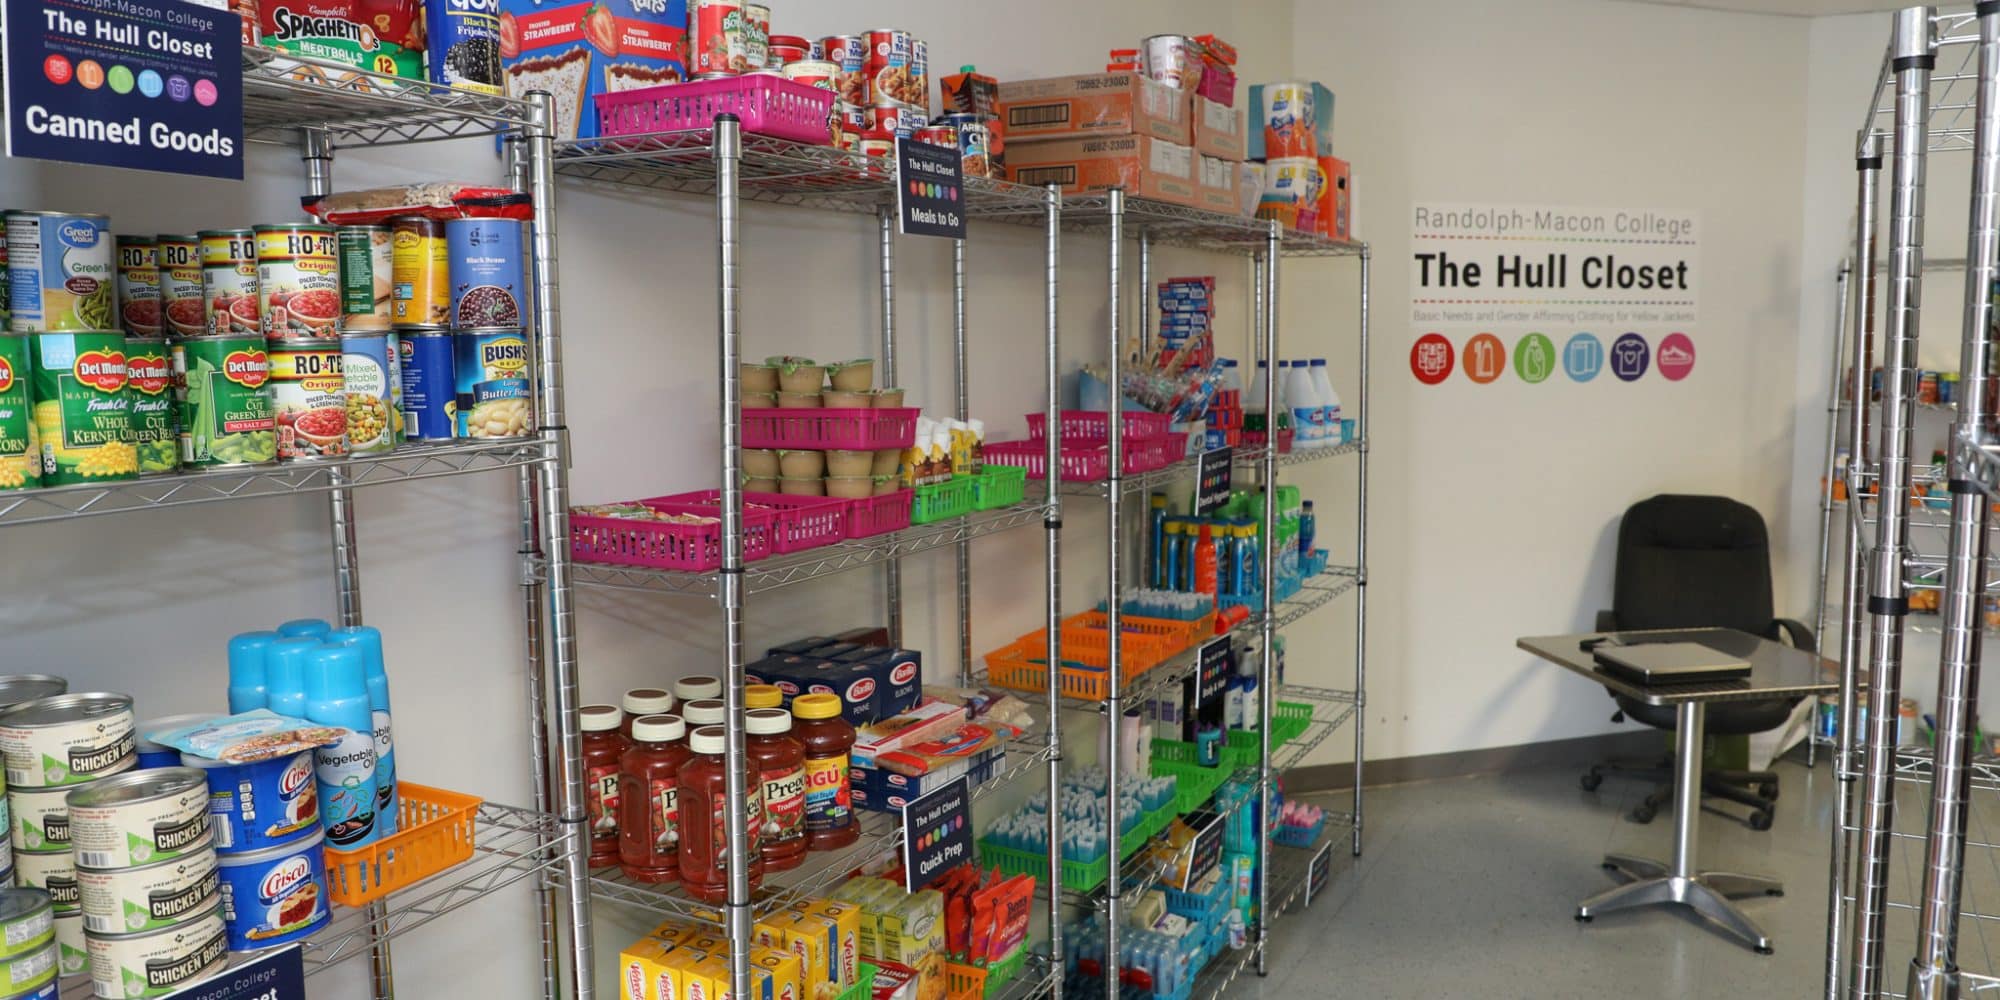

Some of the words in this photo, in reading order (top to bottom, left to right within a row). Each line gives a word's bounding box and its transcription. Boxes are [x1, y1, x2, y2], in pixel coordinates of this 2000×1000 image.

[167, 10, 214, 31] College
[43, 9, 87, 36] The
[95, 19, 140, 46] Hull
[147, 30, 213, 60] Closet
[524, 22, 577, 41] STRAWBERRY
[622, 34, 672, 51] STRAWBERRY
[300, 41, 363, 64] MEATBALLS
[376, 57, 393, 74] 12
[26, 105, 141, 146] Canned
[150, 122, 234, 157] Goods
[908, 158, 921, 170] The
[921, 160, 935, 173] Hull
[936, 163, 956, 177] Closet
[911, 207, 937, 225] Meals
[937, 212, 946, 226] to
[947, 212, 959, 227] Go
[1415, 206, 1605, 235] Randolph-Macon
[1615, 212, 1692, 240] College
[64, 226, 94, 238] Great
[72, 262, 103, 273] Green
[1414, 251, 1481, 288] The
[1497, 253, 1567, 289] Hull
[1581, 255, 1689, 290] Closet
[1413, 310, 1440, 322] Basic
[1442, 310, 1473, 322] Needs
[1476, 310, 1494, 322] and
[1496, 310, 1530, 322] Gender
[1532, 310, 1575, 325] Affirming
[1577, 310, 1614, 325] Clothing
[1616, 310, 1629, 321] for
[1631, 310, 1660, 322] Yellow
[79, 362, 100, 376] Del
[128, 367, 145, 378] Del
[228, 361, 247, 373] Del
[346, 364, 377, 373] Mixed
[482, 389, 512, 400] Butter
[246, 400, 264, 411] CUT
[93, 416, 129, 429] WHOLE
[146, 417, 166, 429] CUT
[224, 410, 256, 421] GREEN
[73, 430, 119, 443] KERNEL
[136, 430, 158, 441] REEN
[896, 663, 916, 681] Barilla
[852, 679, 875, 699] Barilla
[853, 703, 870, 716] PENNE
[72, 747, 119, 773] CHICKEN
[319, 748, 373, 767] Vegetable
[915, 814, 928, 829] The
[928, 806, 941, 821] Hull
[942, 796, 961, 814] Closet
[157, 822, 202, 850] CHICKEN
[920, 848, 944, 876] Quick
[944, 841, 963, 860] Prep
[265, 862, 306, 898] Crisco
[153, 890, 201, 917] CHICKEN
[149, 957, 202, 985] CHICKEN
[233, 967, 277, 992] College
